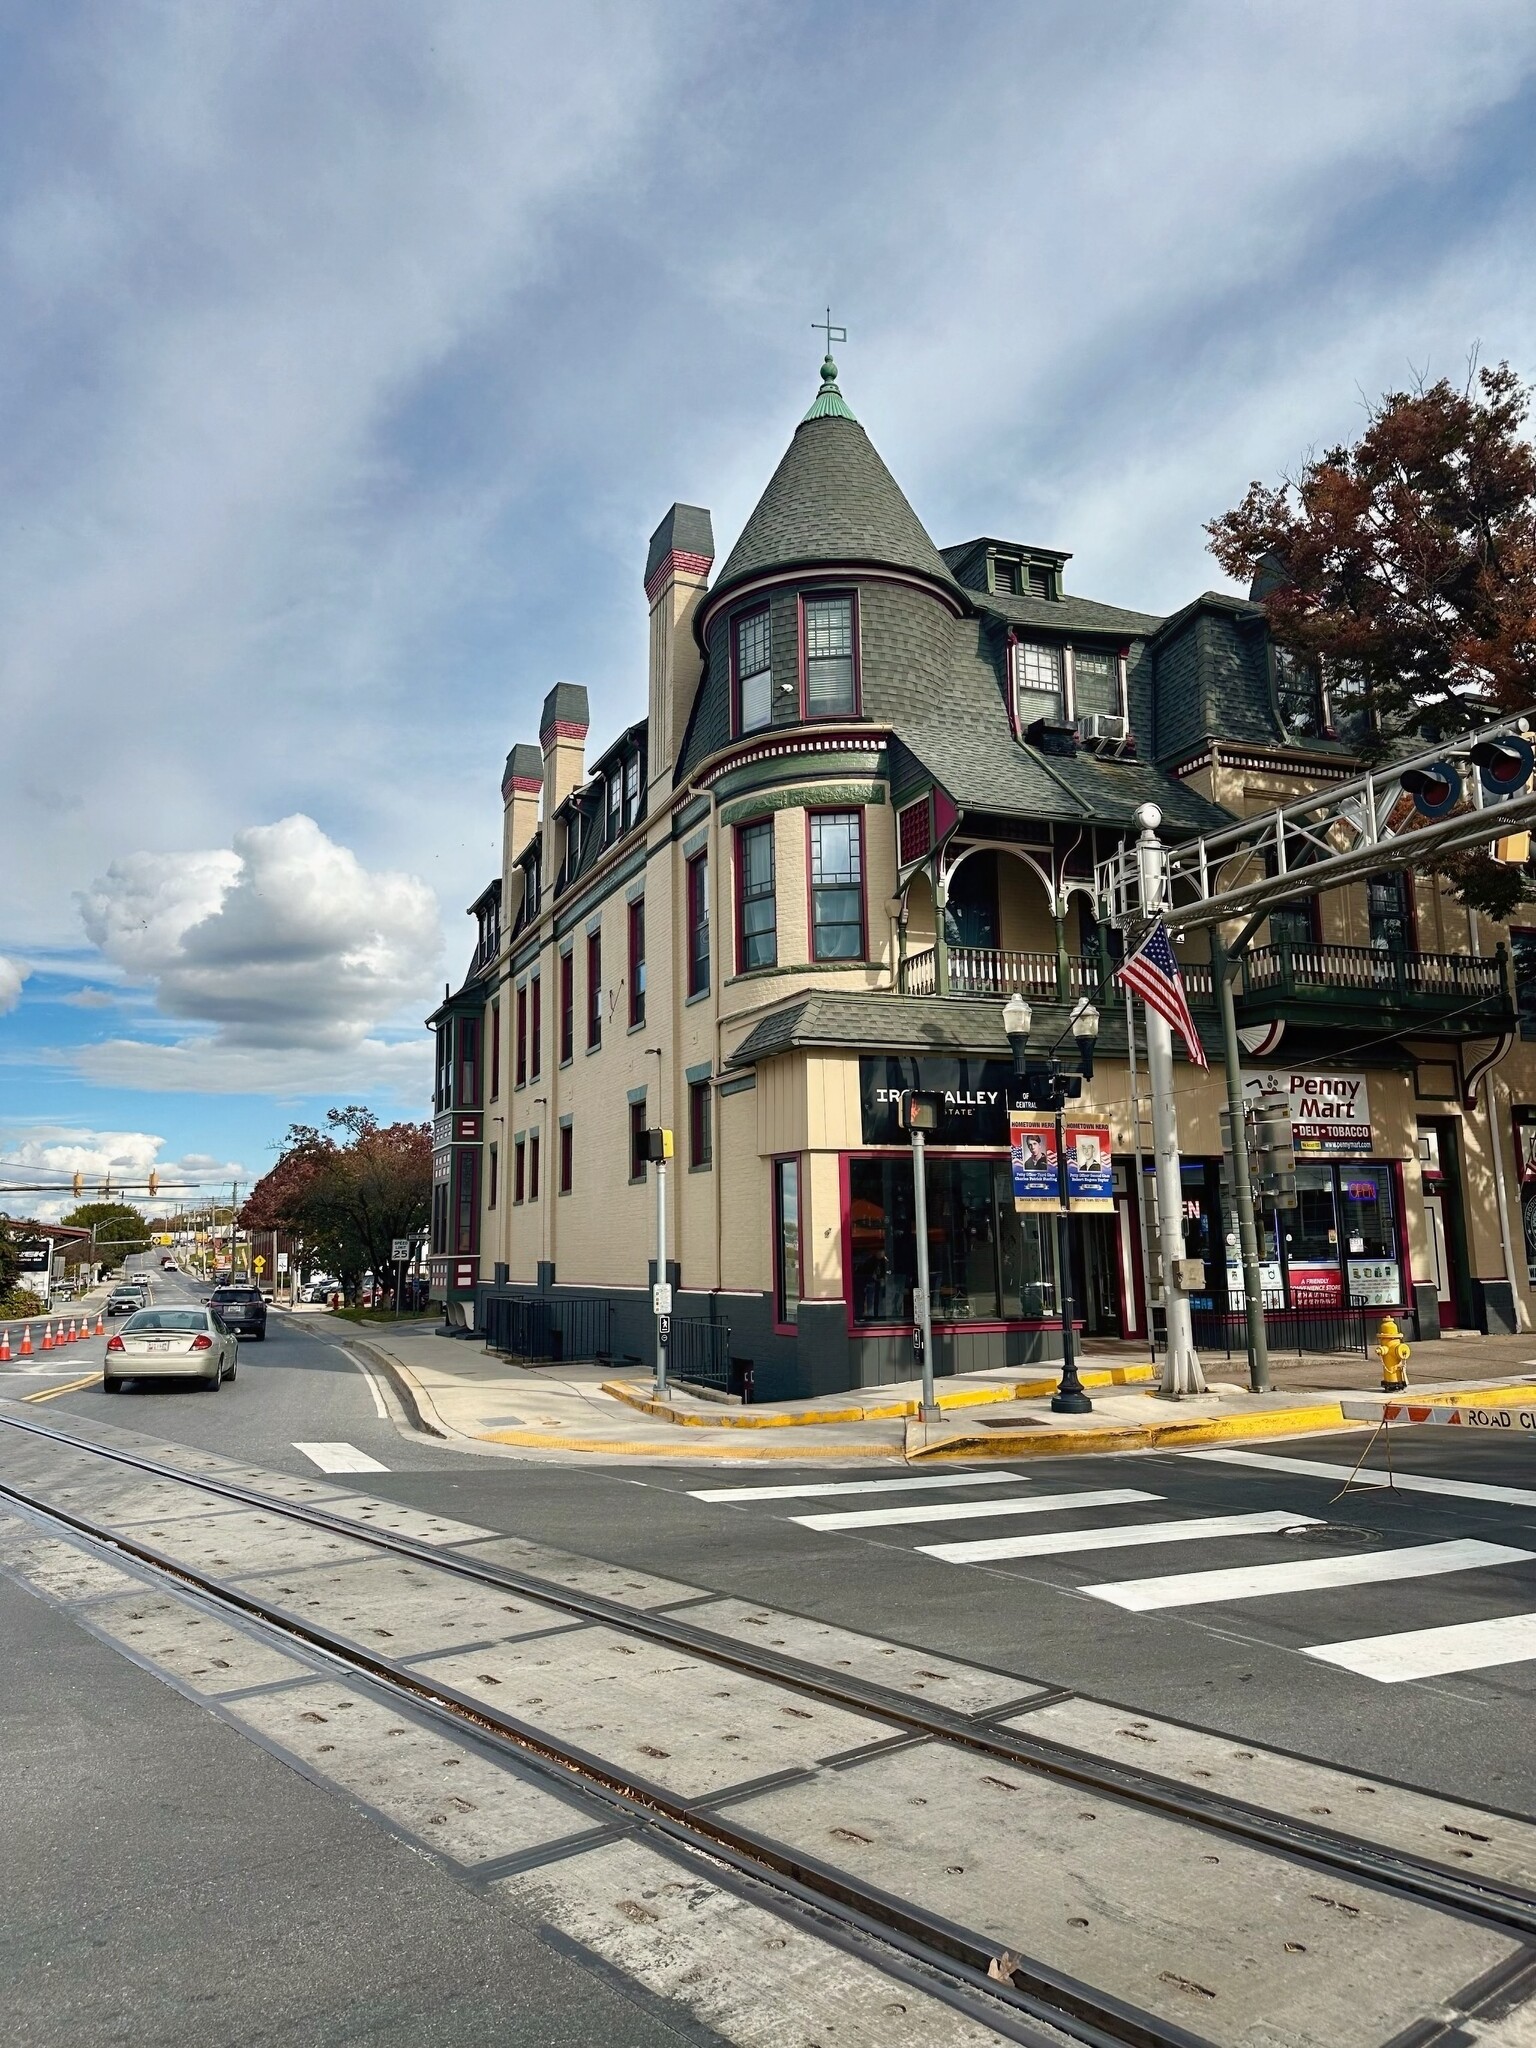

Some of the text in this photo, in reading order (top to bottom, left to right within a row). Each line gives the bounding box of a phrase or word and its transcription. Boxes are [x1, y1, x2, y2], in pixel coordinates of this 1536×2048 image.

[1289, 1075, 1360, 1099] Penny
[1022, 1092, 1030, 1100] OF
[1015, 1101, 1038, 1109] CENTRAL
[1299, 1098, 1355, 1118] Mart
[1067, 1122, 1094, 1130] HOMETOWN
[1299, 1125, 1369, 1137] DELI TOBACCO
[1324, 1141, 1371, 1149] www.pennymart.com
[1350, 1183, 1376, 1199] OPEN
[393, 1250, 408, 1259] 25
[1306, 1277, 1329, 1285] FRIENDLY
[1468, 1410, 1511, 1428] ROAD
